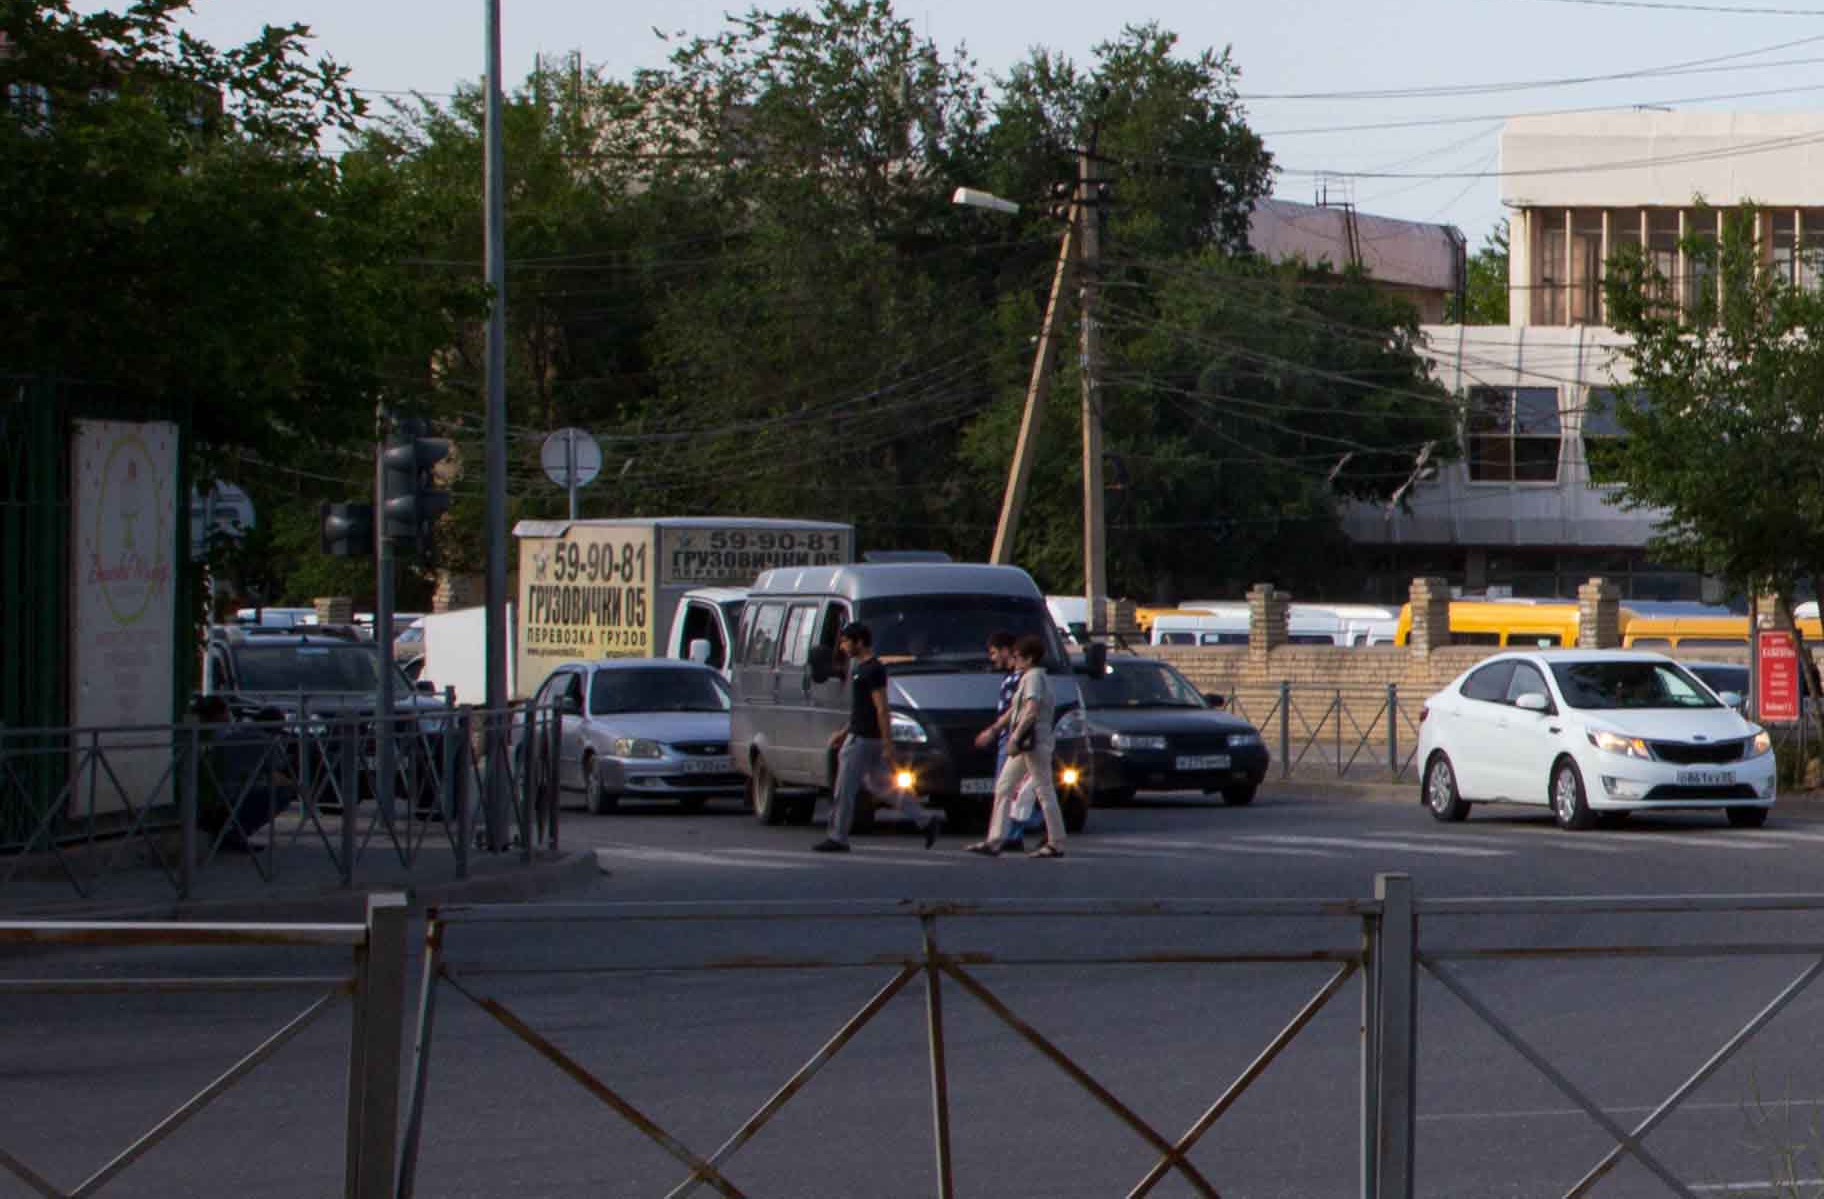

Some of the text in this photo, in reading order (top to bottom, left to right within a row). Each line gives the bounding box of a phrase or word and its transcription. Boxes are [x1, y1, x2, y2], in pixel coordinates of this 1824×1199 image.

[711, 531, 841, 551] 59-90-81
[553, 541, 647, 584] 59-90-81
[528, 585, 646, 627] ГРУЗОВИЧКИ 05
[527, 627, 647, 647] ПЕРЕВОЗКА ГРУЗОВ
